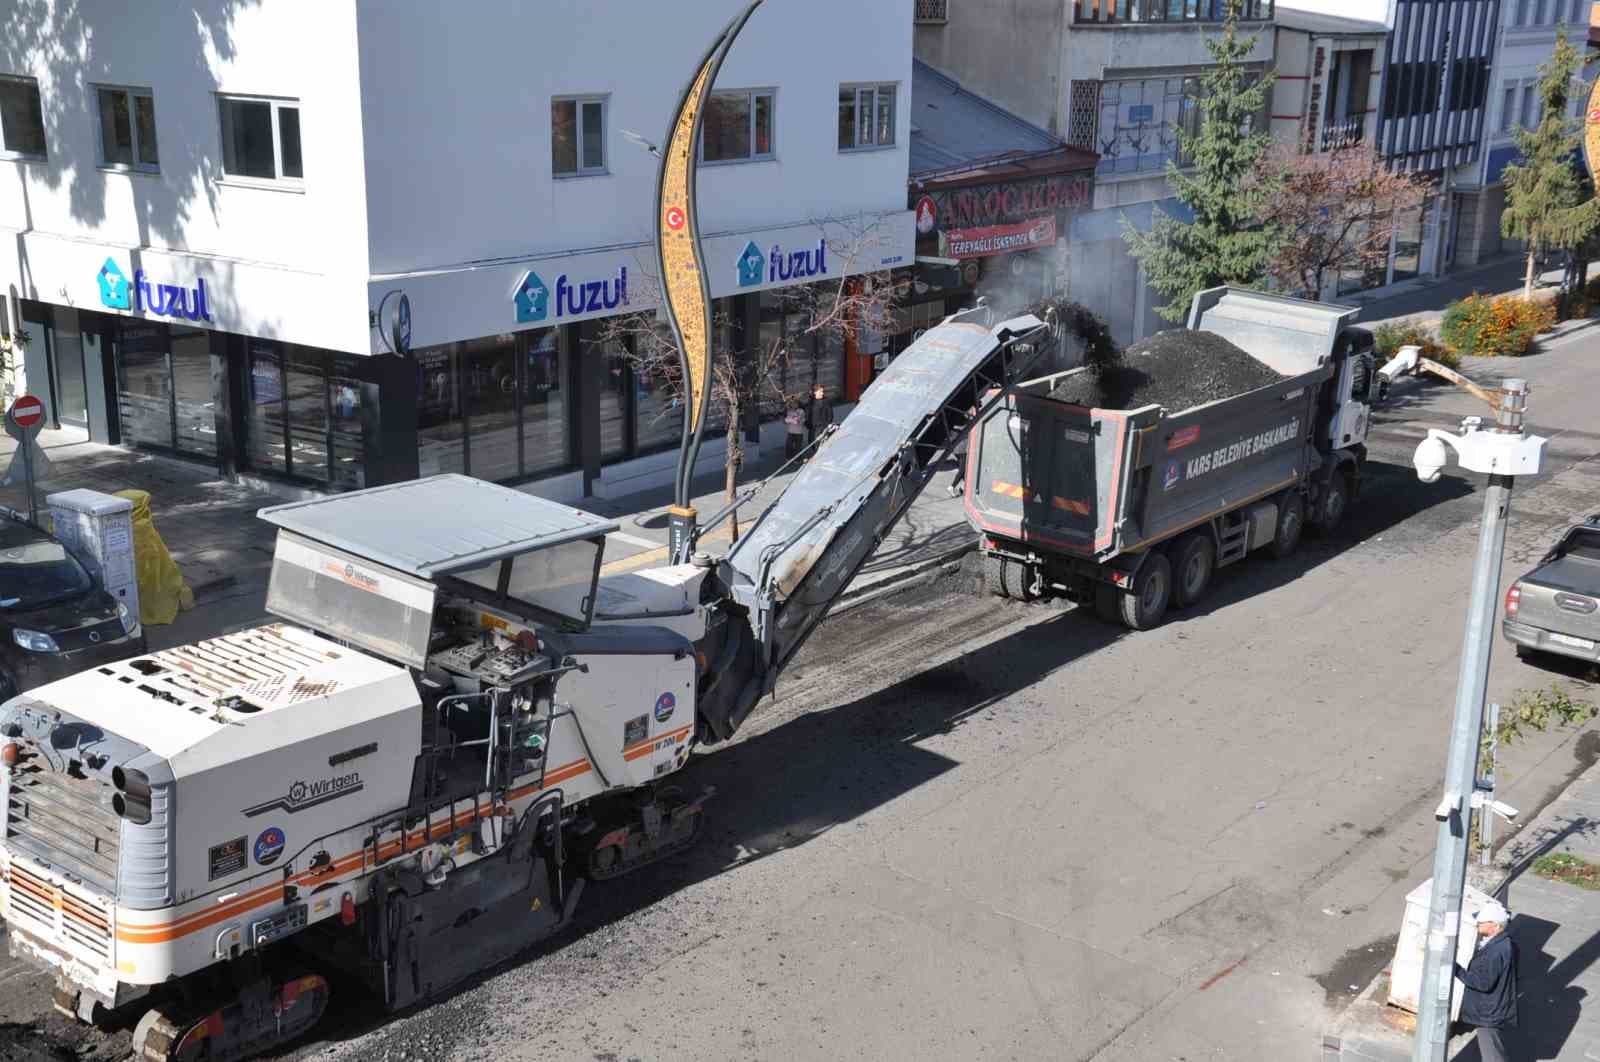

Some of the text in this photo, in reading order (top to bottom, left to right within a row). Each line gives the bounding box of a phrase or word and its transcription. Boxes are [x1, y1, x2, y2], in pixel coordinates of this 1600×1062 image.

[769, 238, 827, 282] fuzul
[134, 268, 211, 323] fuzul
[556, 267, 630, 317] fuzul
[1186, 453, 1212, 480] KARS
[1212, 436, 1253, 470] BELEDİYE
[310, 772, 359, 796] Wirtgen
